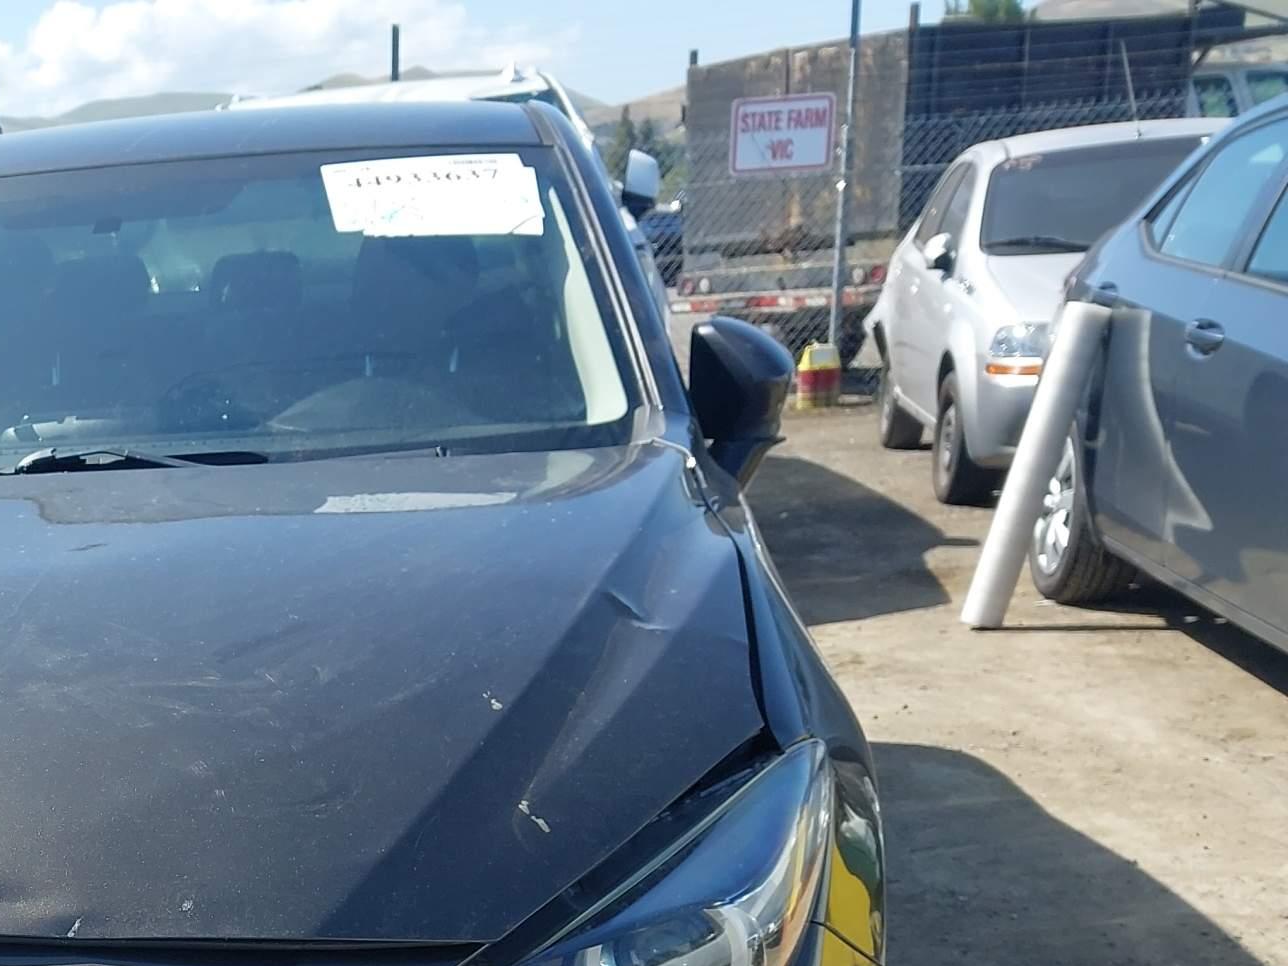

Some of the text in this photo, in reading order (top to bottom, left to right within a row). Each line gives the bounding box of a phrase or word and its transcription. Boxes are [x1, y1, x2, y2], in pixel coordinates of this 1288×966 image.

[740, 106, 828, 133] STATE FARM
[767, 138, 794, 161] VIC
